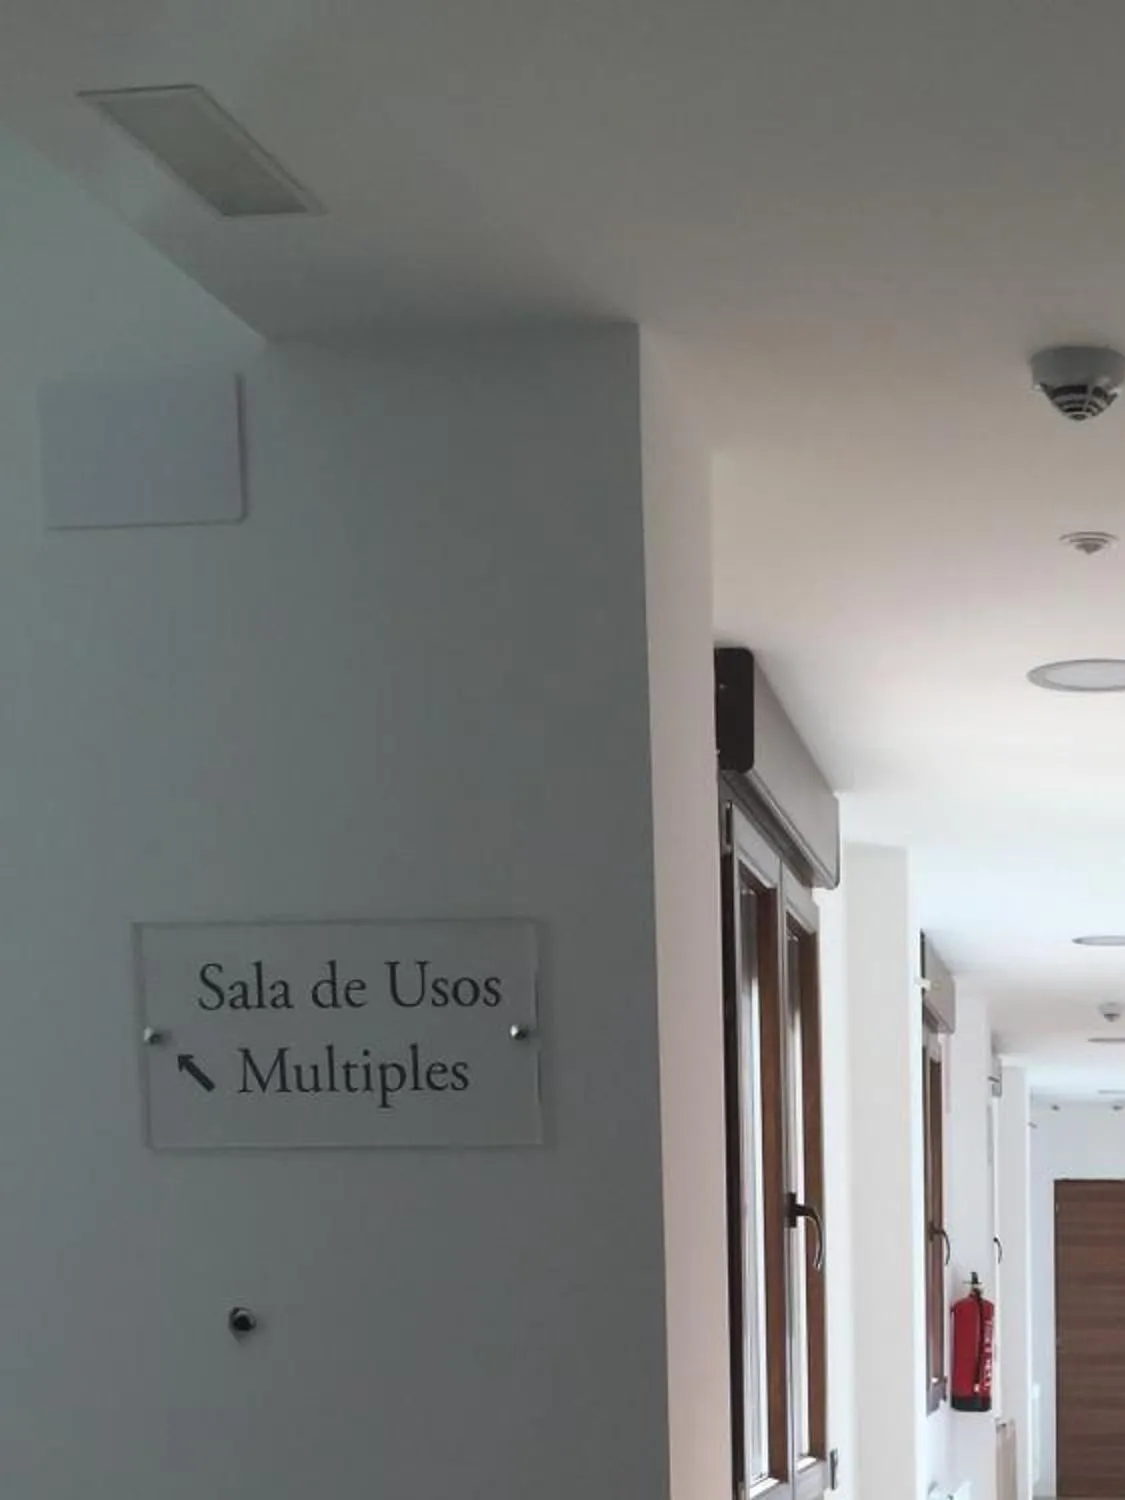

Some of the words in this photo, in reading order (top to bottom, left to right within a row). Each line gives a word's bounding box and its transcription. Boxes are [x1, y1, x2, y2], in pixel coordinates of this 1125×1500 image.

[198, 960, 294, 1011] Sala
[311, 960, 368, 1009] de
[384, 960, 503, 1009] Usos
[237, 1043, 470, 1109] Multiples
